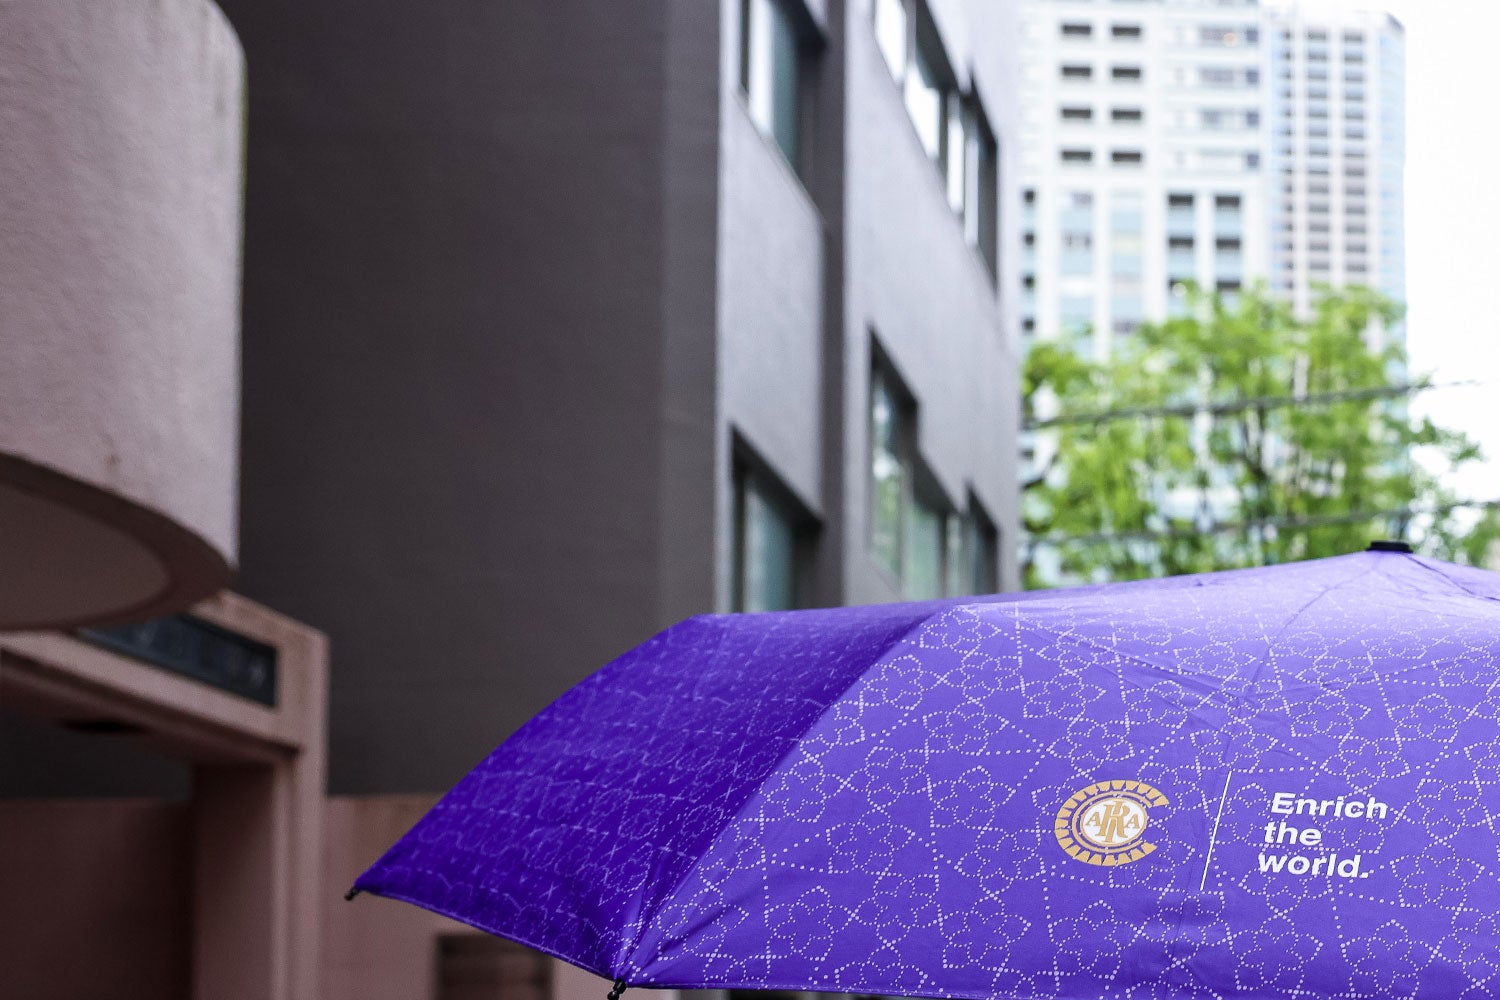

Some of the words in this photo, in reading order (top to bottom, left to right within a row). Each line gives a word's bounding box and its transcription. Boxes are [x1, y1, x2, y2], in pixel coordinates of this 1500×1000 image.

[1271, 792, 1388, 819] Enrich
[1264, 821, 1322, 846] the
[1258, 853, 1369, 878] world.
